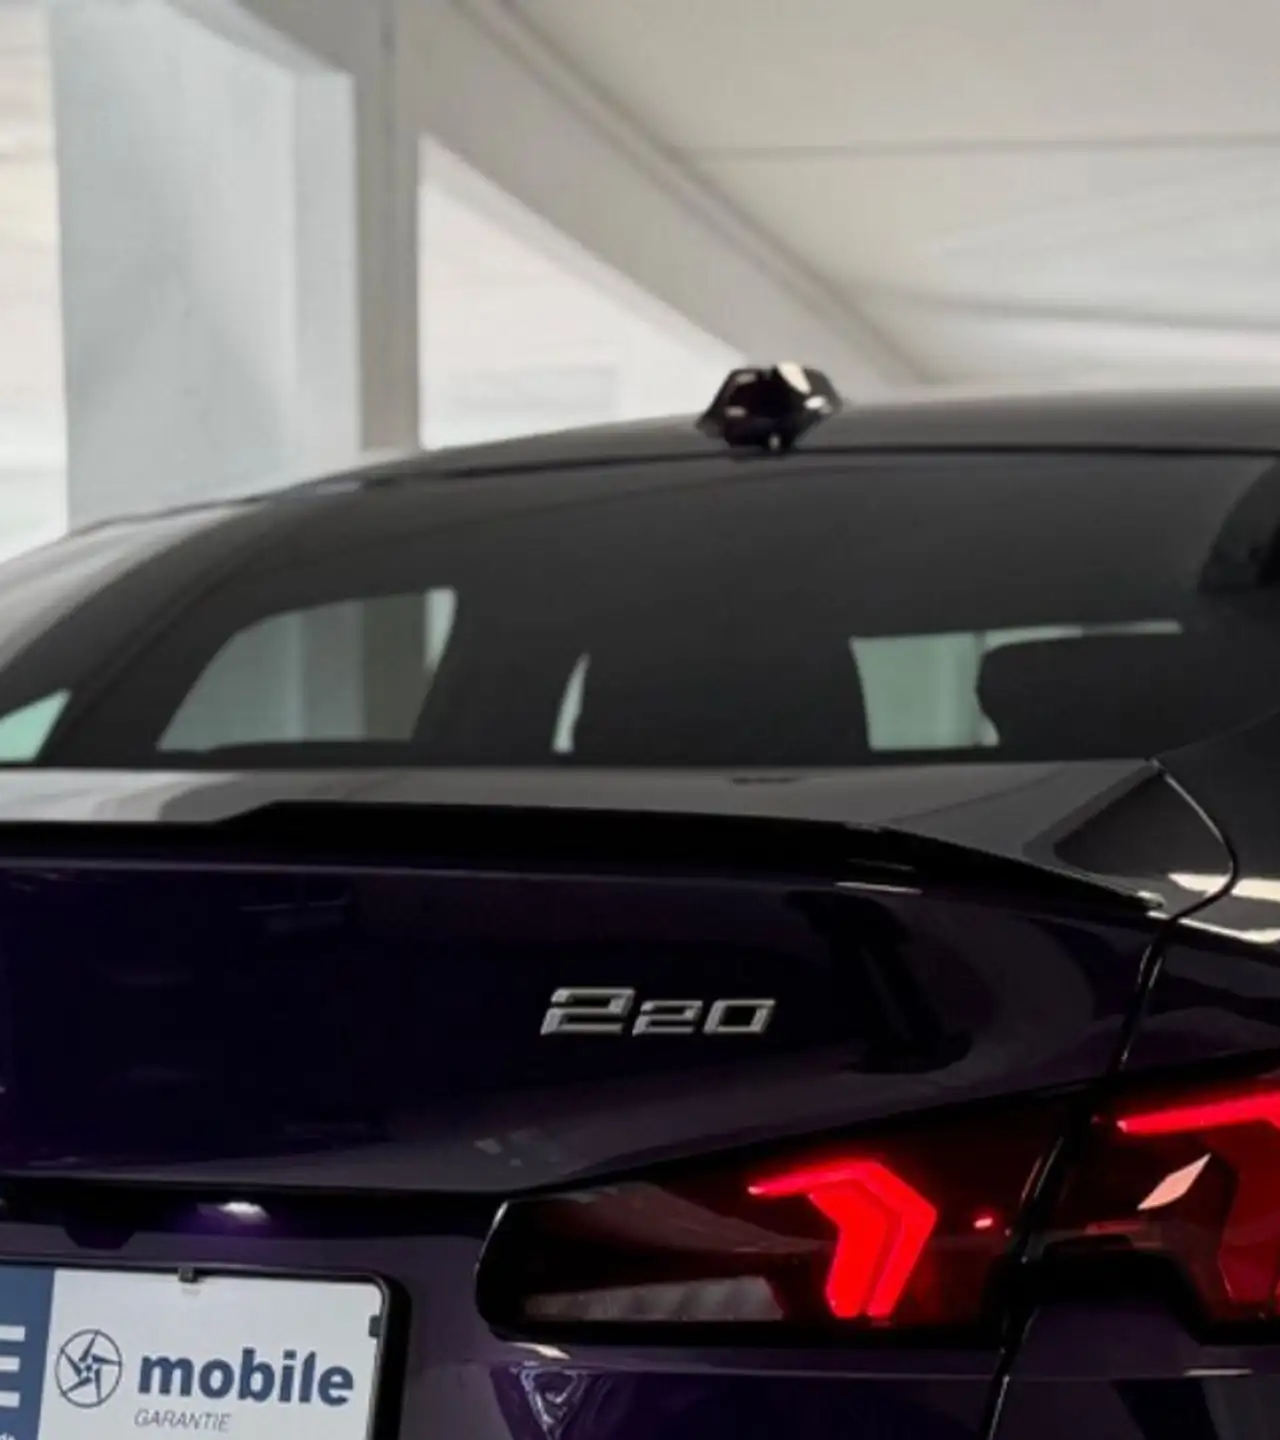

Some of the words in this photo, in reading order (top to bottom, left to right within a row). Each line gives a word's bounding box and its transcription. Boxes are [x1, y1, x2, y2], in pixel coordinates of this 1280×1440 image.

[540, 987, 776, 1035] 220
[138, 1347, 354, 1406] mobile
[133, 1408, 232, 1433] GARANTIE
